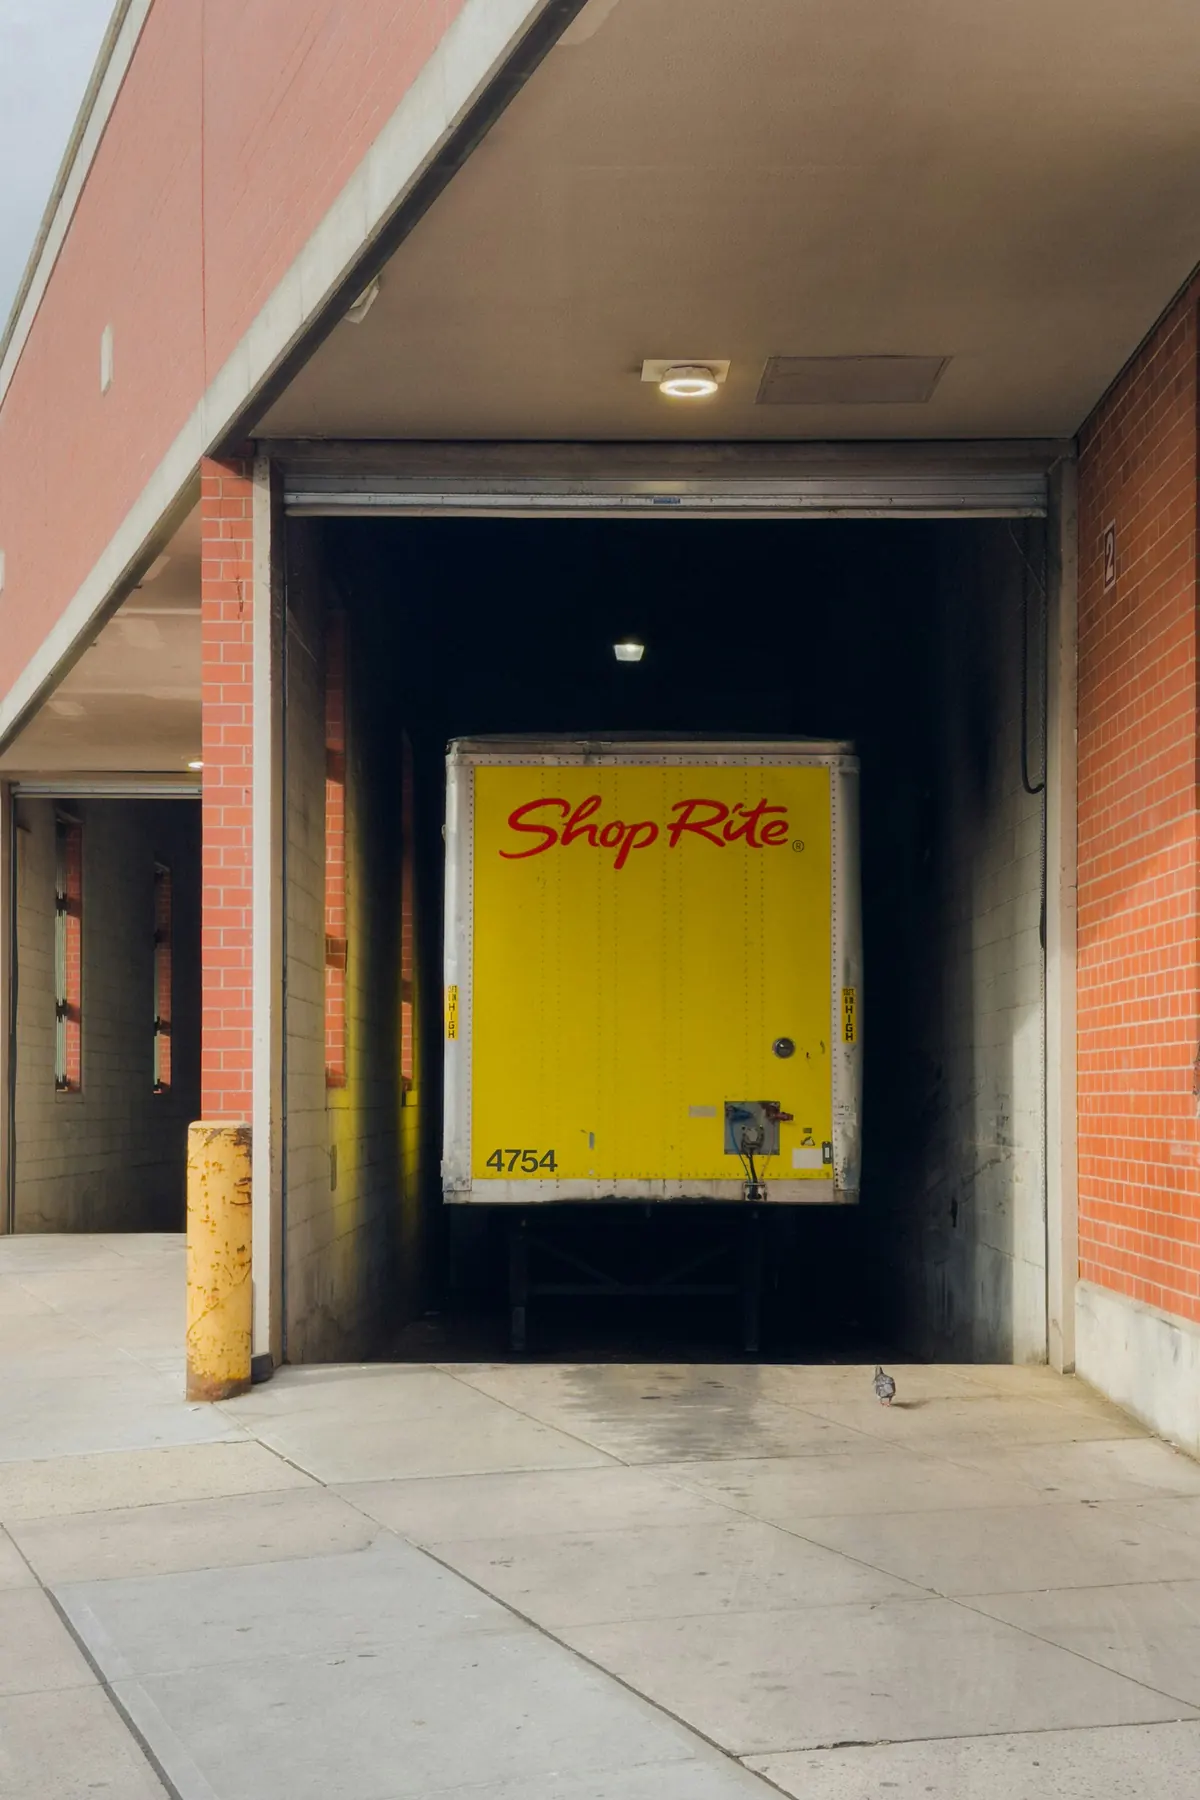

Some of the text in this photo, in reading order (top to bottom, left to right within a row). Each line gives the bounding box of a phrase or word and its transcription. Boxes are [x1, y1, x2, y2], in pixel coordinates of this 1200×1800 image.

[1106, 531, 1114, 583] 2
[447, 1002, 456, 1039] HIGH
[845, 1005, 855, 1041] HIGH
[486, 1148, 558, 1173] 4754
